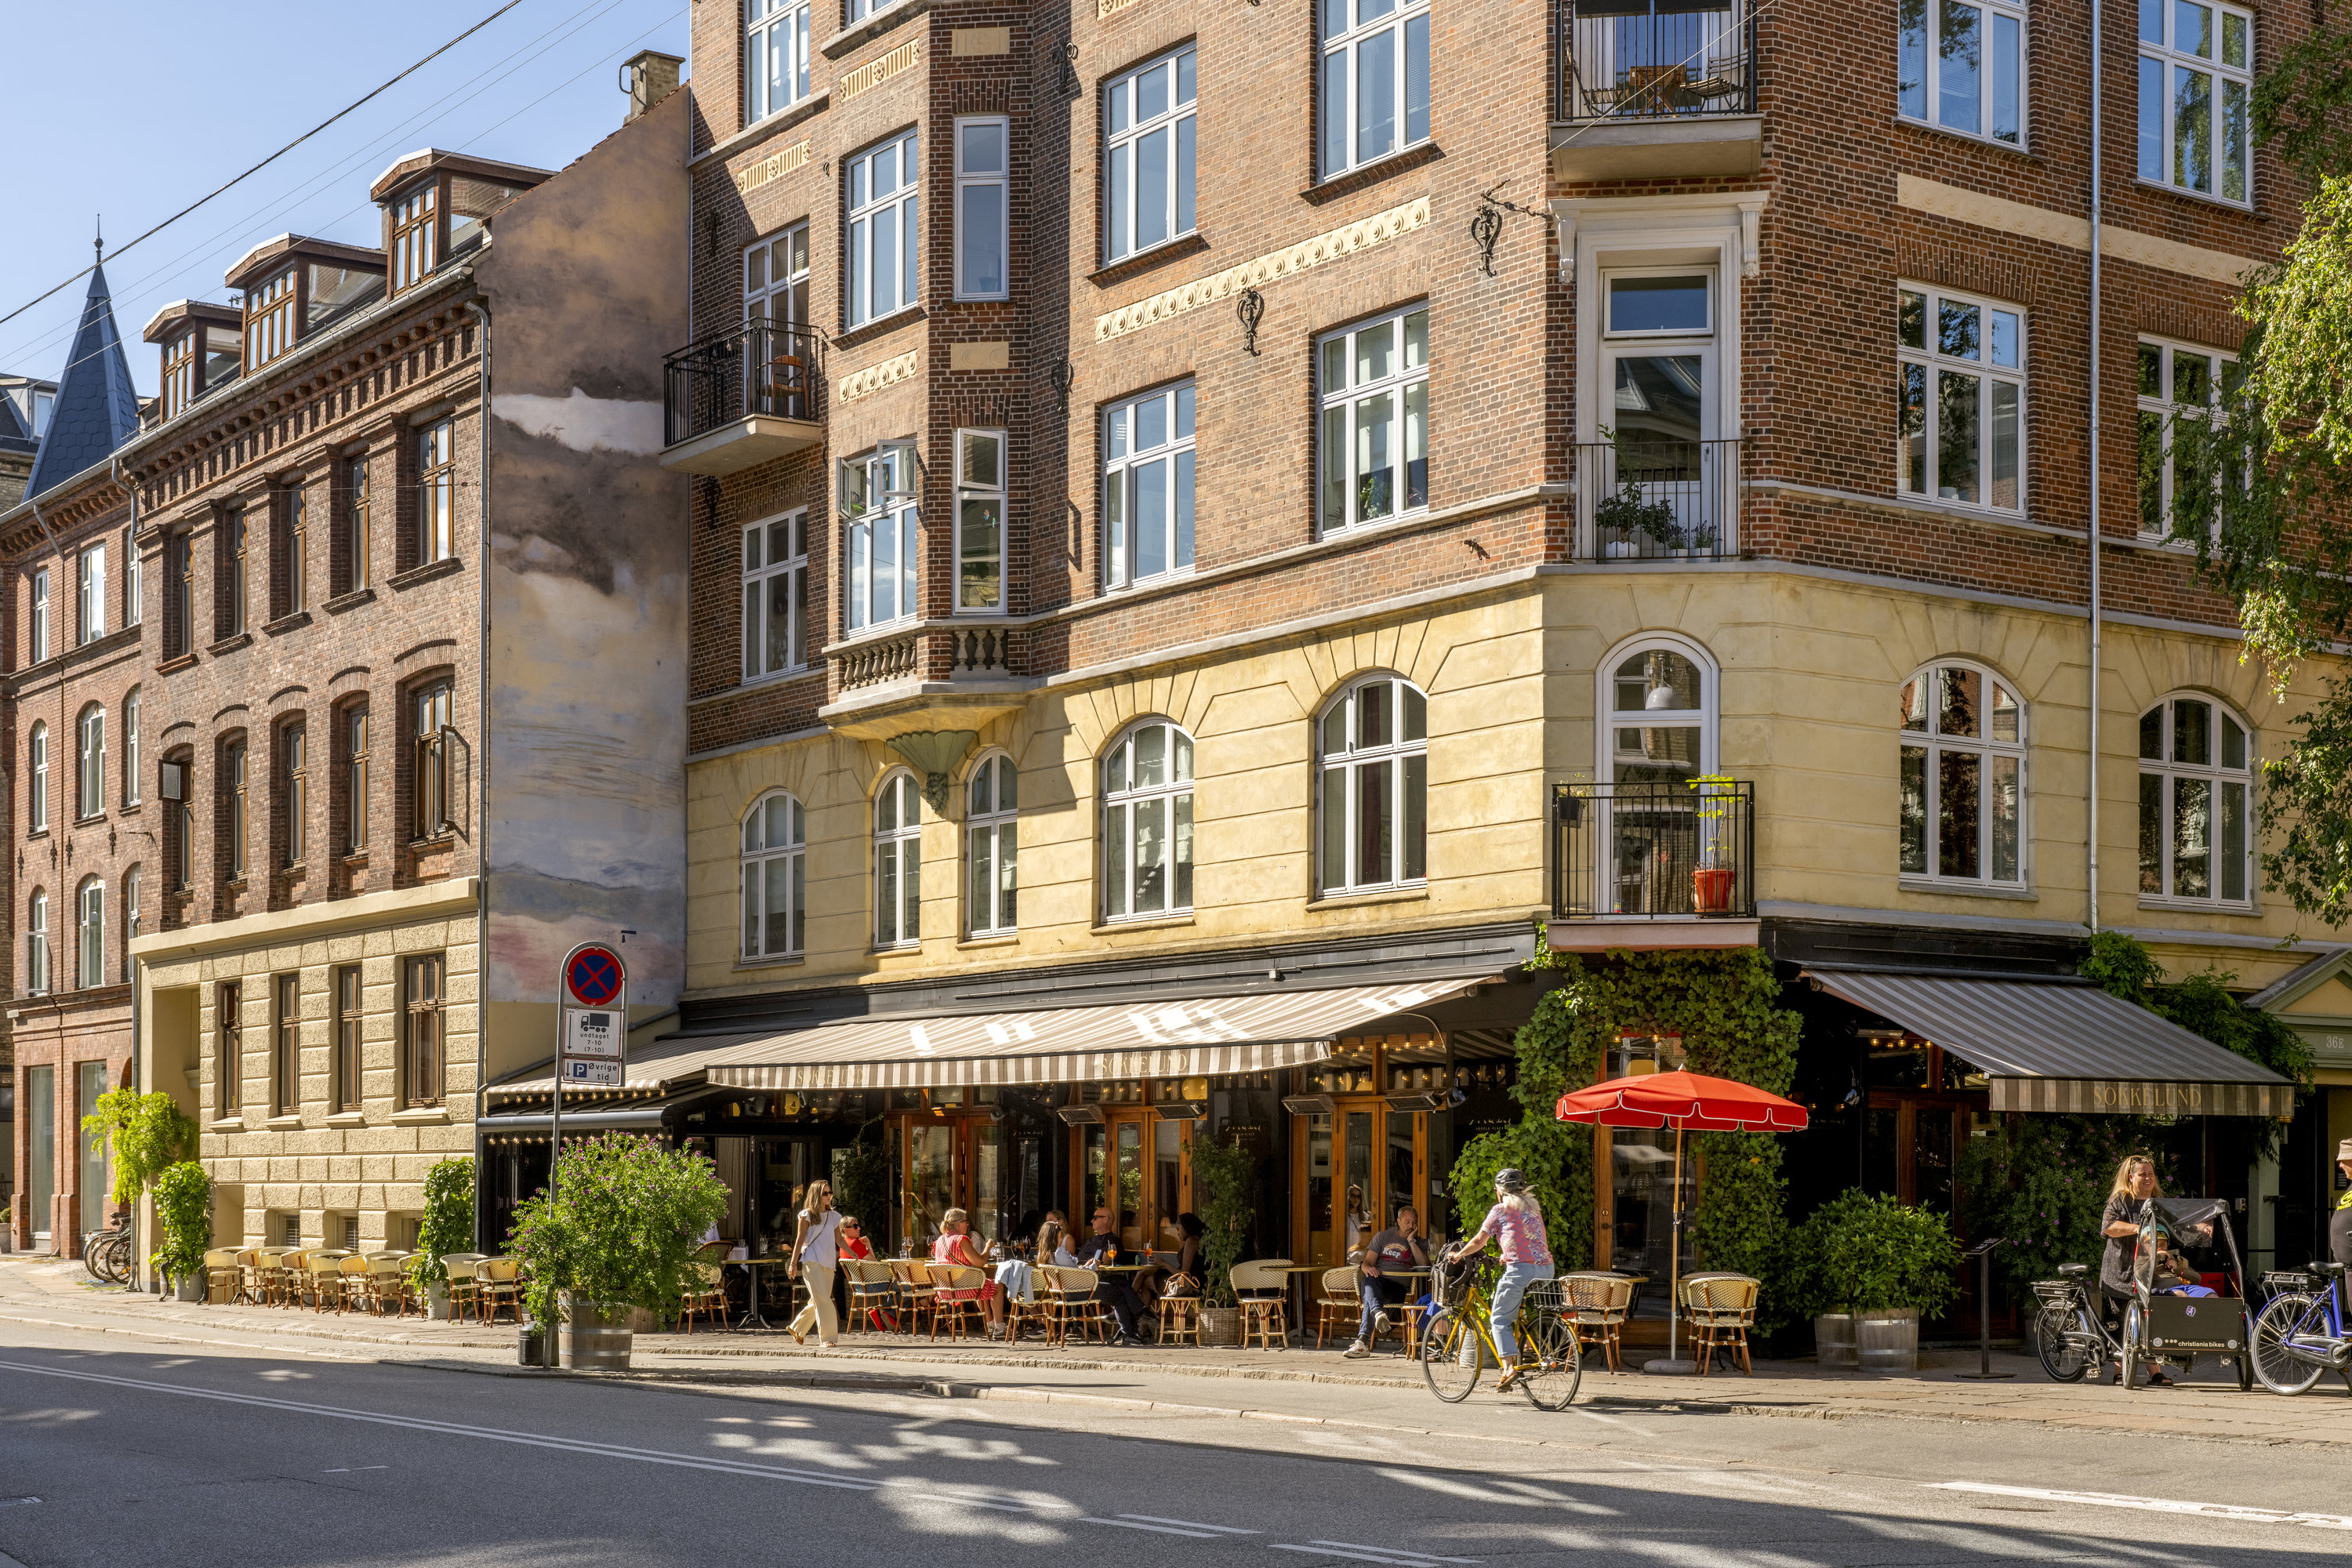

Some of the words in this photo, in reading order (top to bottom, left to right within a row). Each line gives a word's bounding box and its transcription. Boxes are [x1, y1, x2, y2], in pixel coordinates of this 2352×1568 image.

[2326, 1035, 2344, 1048] 36E
[576, 1064, 585, 1076] P
[588, 1062, 617, 1072] Øvrige
[1102, 1054, 1187, 1074] SOKKELUND
[2093, 1086, 2201, 1107] SOKKELUND
